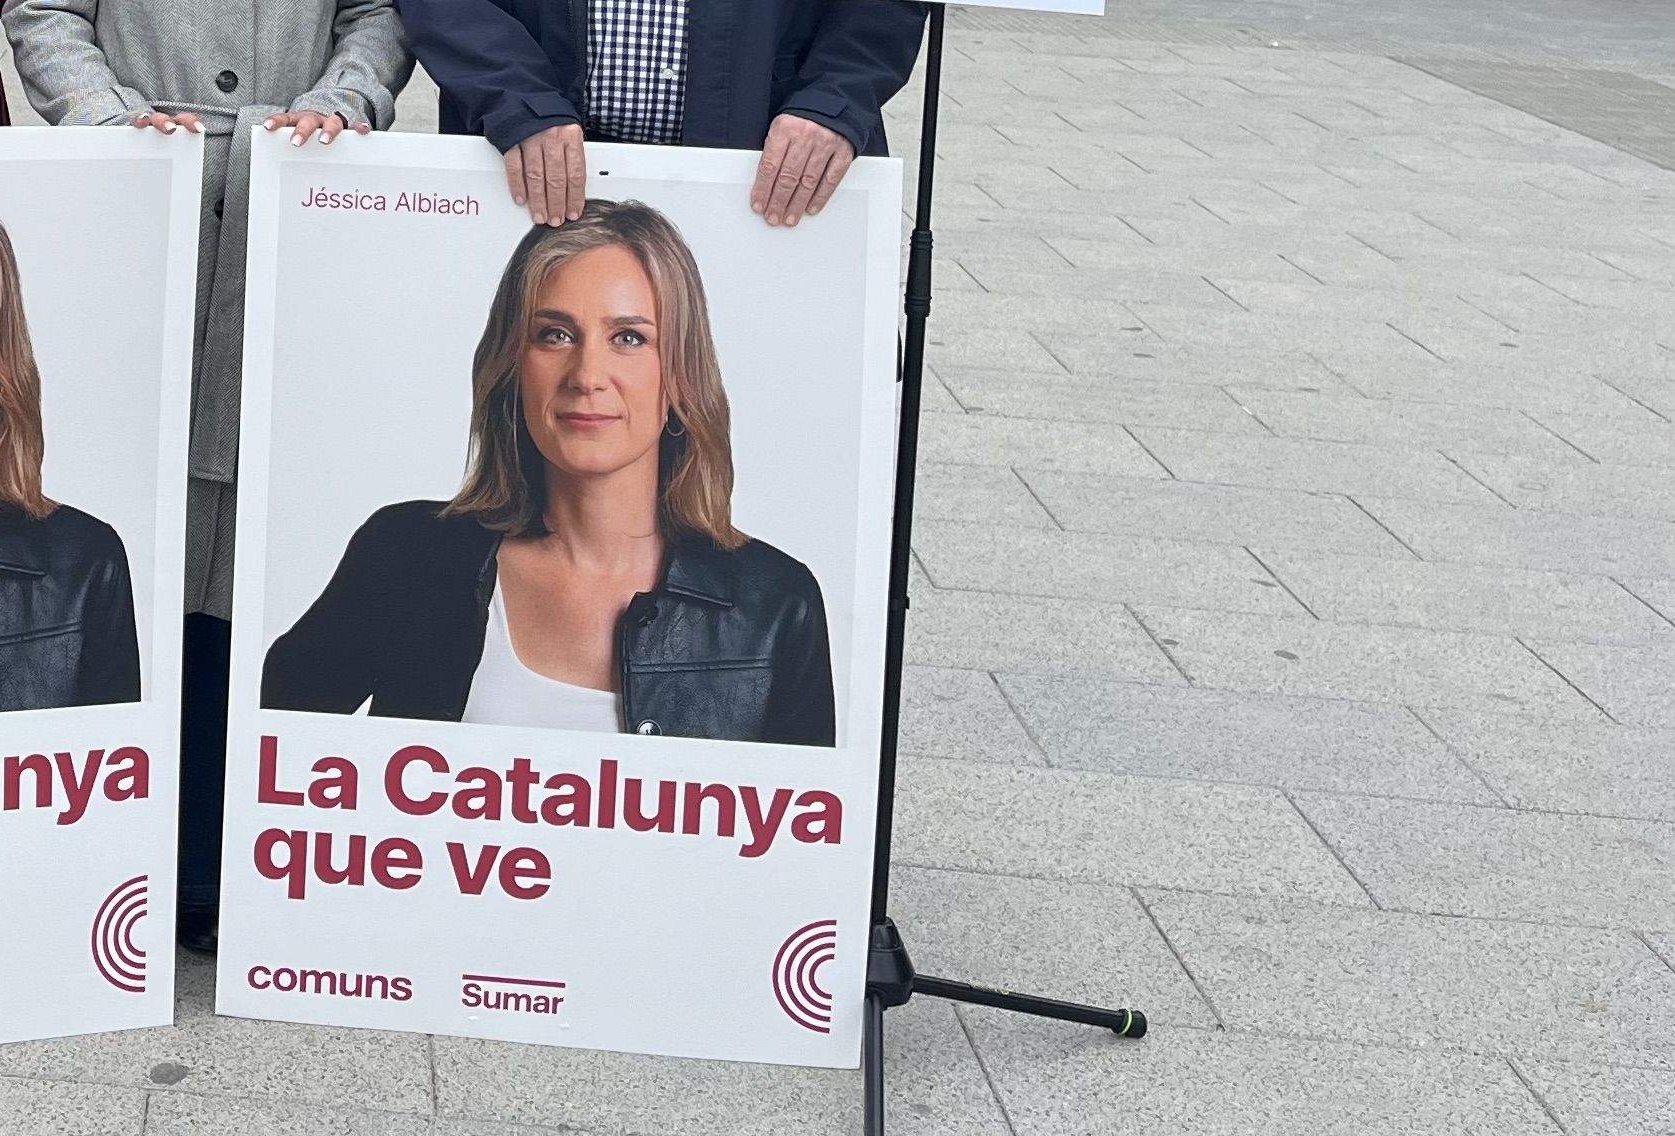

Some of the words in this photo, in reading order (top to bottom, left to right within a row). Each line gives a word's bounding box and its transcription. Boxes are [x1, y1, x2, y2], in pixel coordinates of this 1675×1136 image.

[300, 186, 387, 211] Jéssica
[394, 191, 480, 216] Albiach
[258, 735, 359, 809] La
[384, 744, 844, 858] Catalunya
[253, 827, 424, 900] que
[447, 841, 552, 900] ve
[247, 965, 413, 1002] comuns
[462, 981, 566, 1014] Sumar
